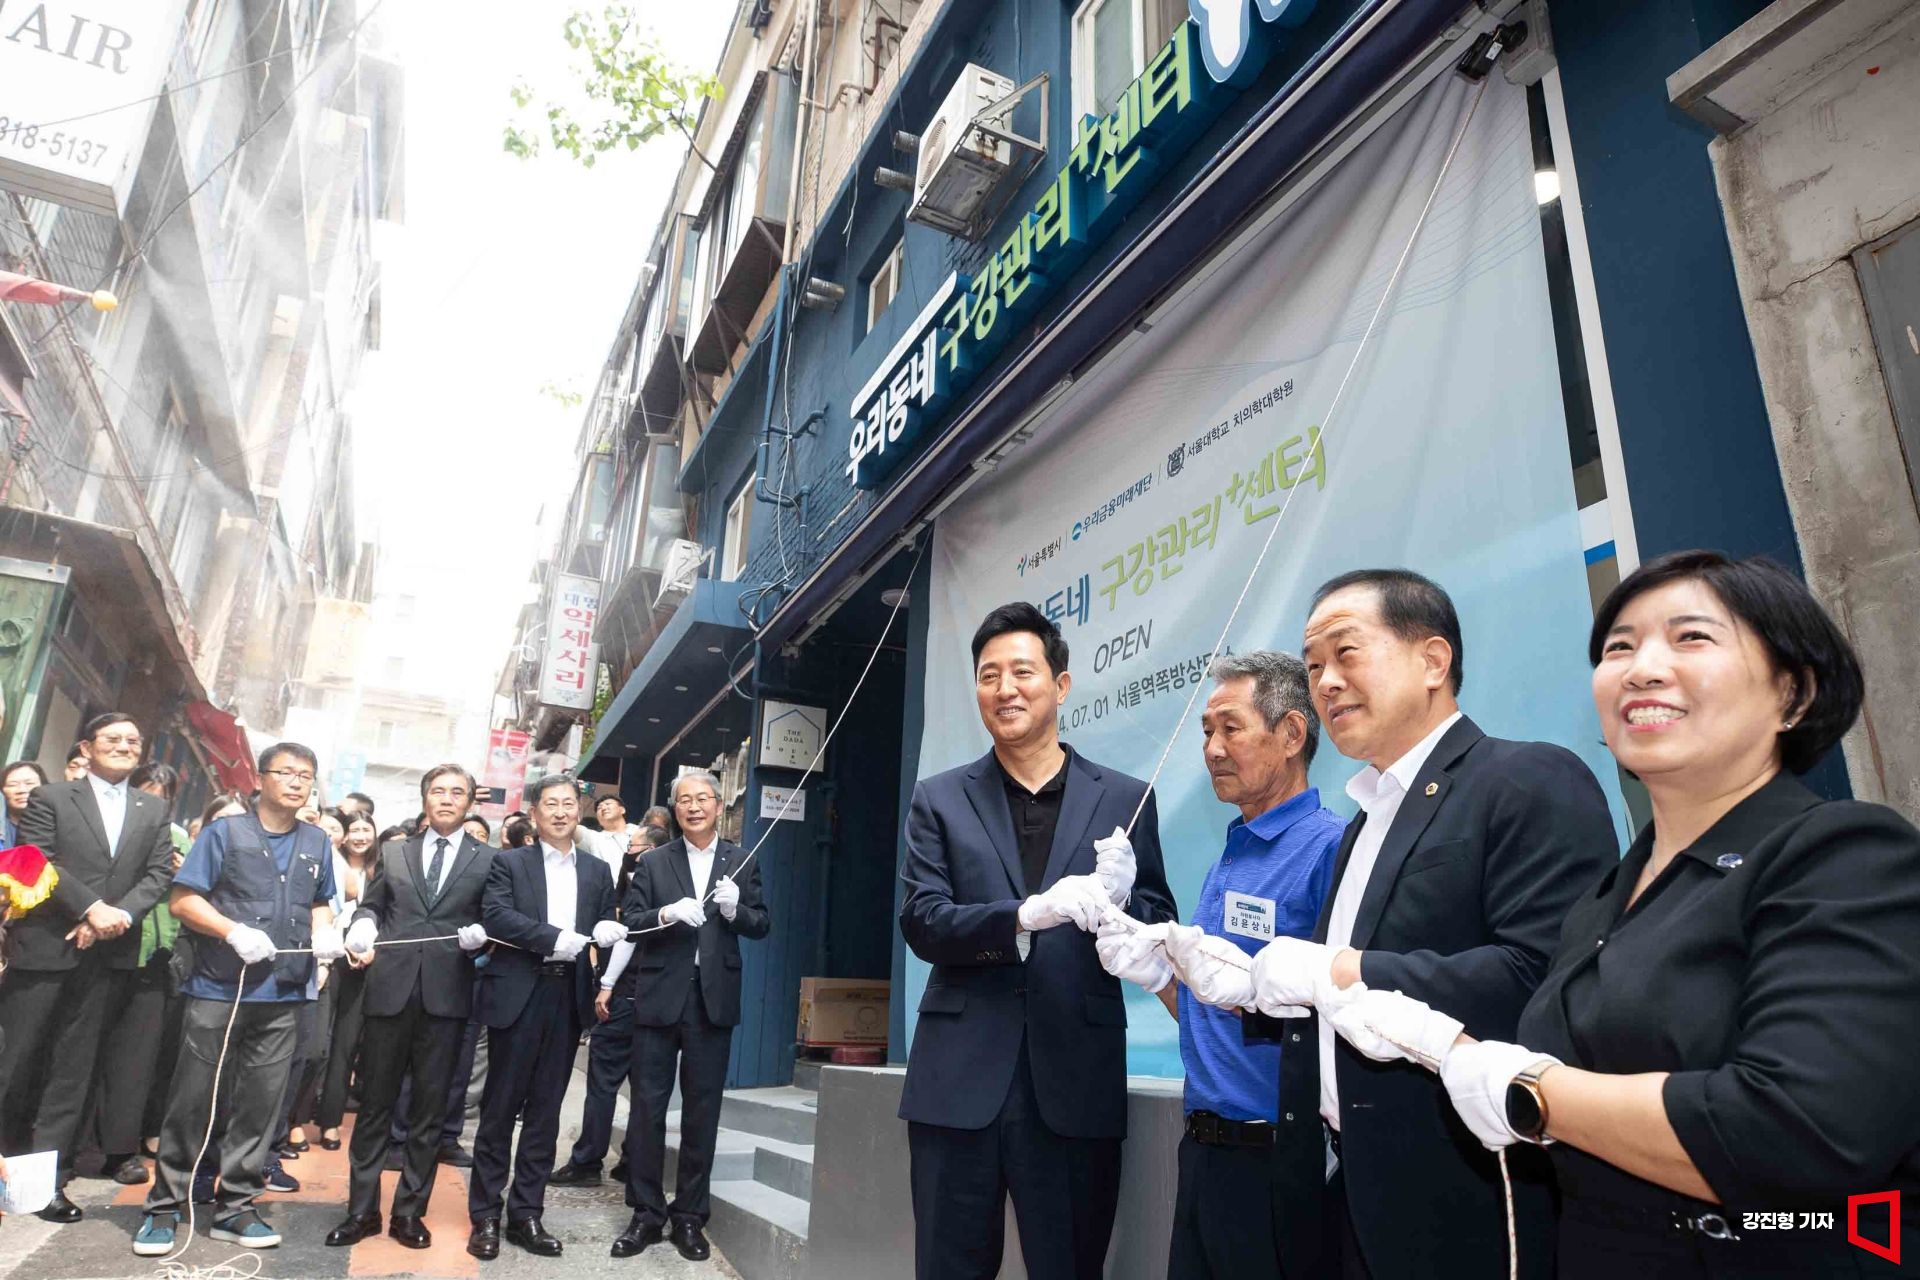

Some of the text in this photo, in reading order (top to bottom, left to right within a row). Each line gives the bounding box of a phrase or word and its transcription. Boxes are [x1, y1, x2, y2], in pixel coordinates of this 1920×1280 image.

[5, 3, 133, 75] AIR
[845, 330, 936, 485] 우리동네
[1027, 378, 1294, 570] 서울특별시 우리금융미래재단 서울대학교 치의학대학원
[1038, 574, 1090, 630] 동네
[1093, 619, 1153, 674] OPEN
[1116, 645, 1234, 709] 서울역쪽방상
